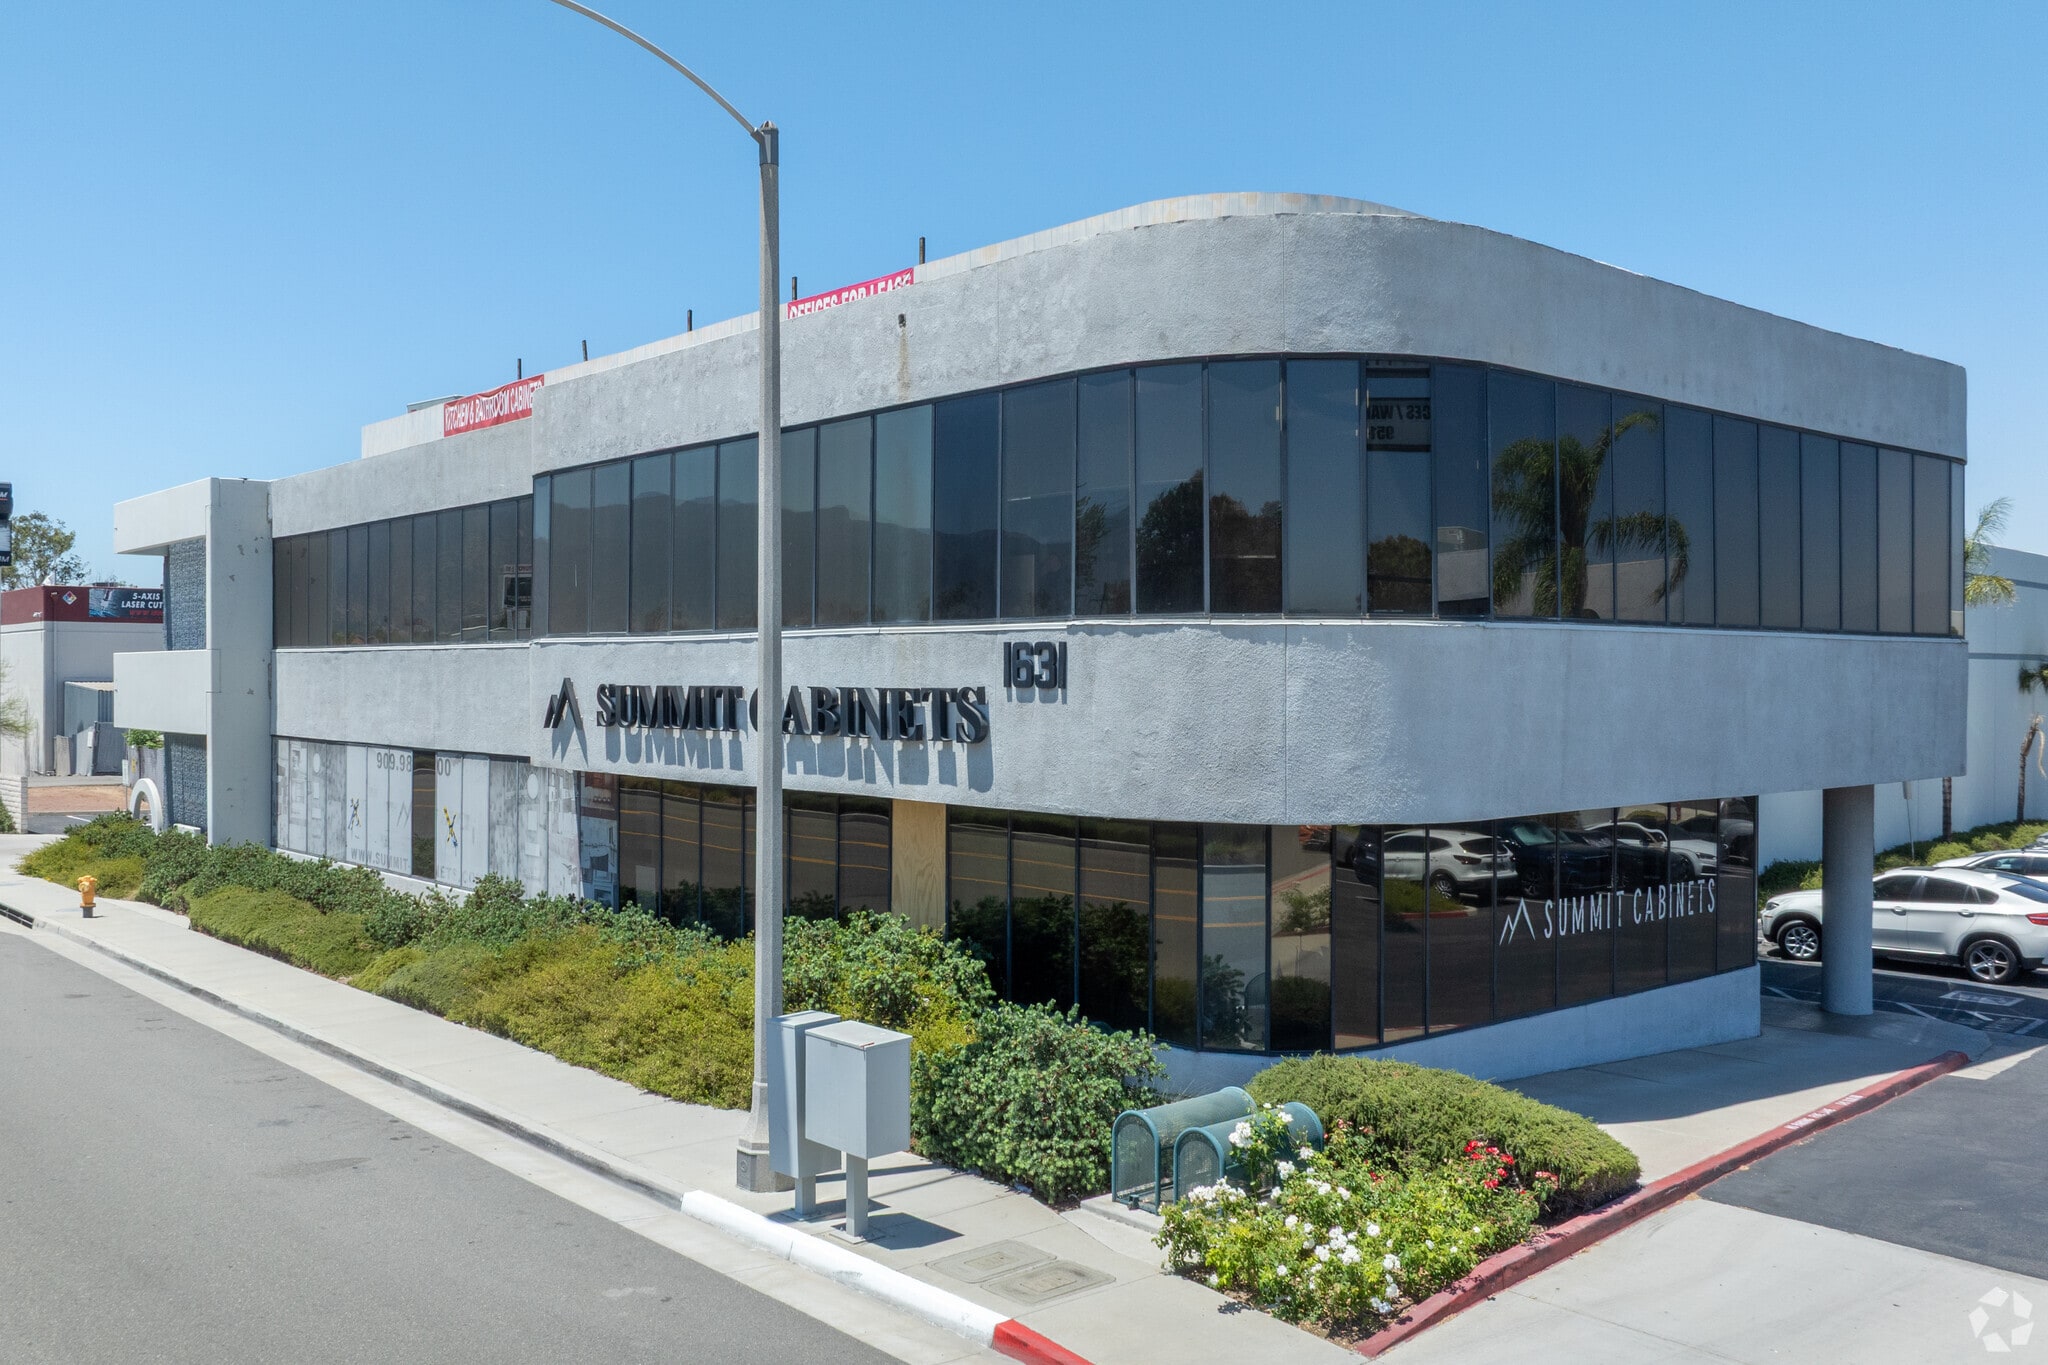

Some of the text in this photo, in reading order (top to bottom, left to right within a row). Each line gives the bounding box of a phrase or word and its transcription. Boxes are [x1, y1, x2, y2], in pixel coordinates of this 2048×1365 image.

[445, 401, 469, 432] KITCHEN
[121, 601, 146, 609] LASER
[132, 592, 161, 600] 5-AXIS
[1003, 641, 1067, 690] 1631
[596, 683, 989, 744] SUMMIT ABINETS
[1543, 878, 1716, 940] SUMMIT CABINETS
